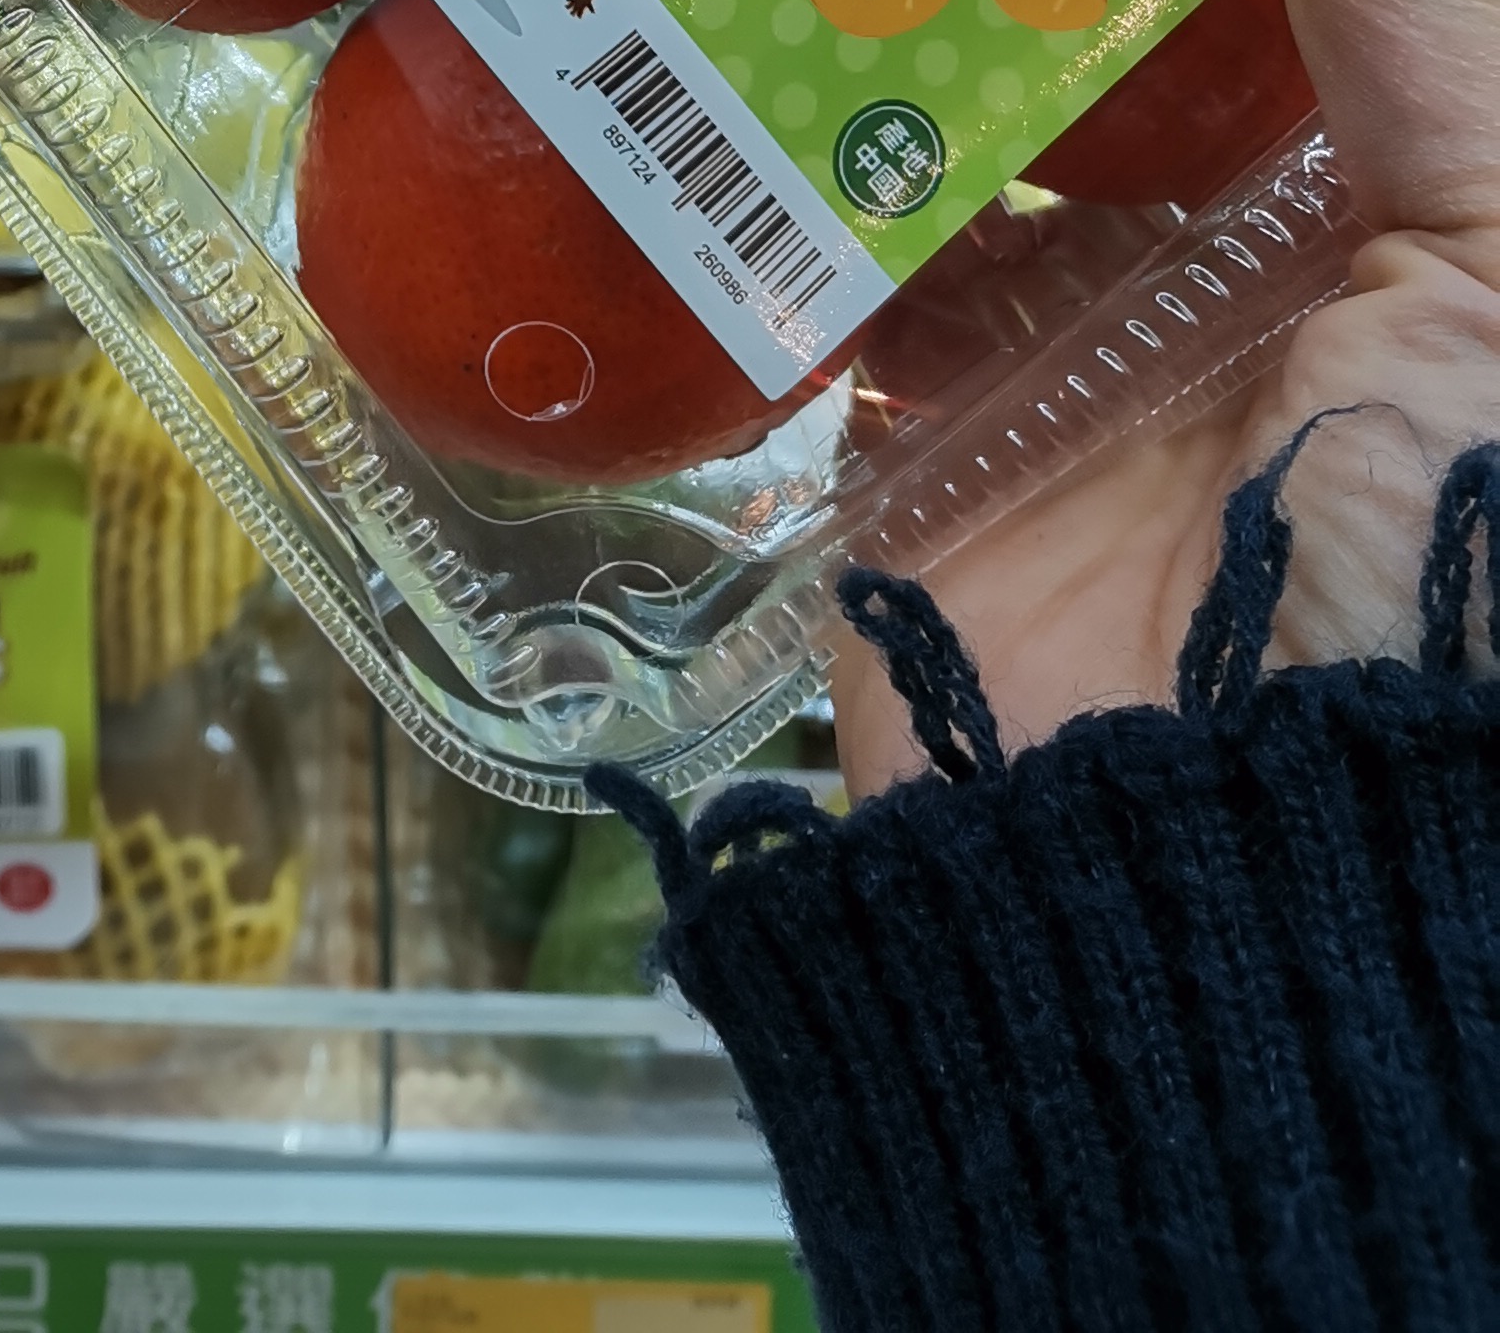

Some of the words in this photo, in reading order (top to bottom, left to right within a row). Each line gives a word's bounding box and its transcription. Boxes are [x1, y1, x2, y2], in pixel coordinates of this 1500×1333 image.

[601, 123, 658, 187] 897124
[855, 143, 907, 203] 中國
[874, 117, 929, 180] 產地
[692, 241, 750, 307] 260986
